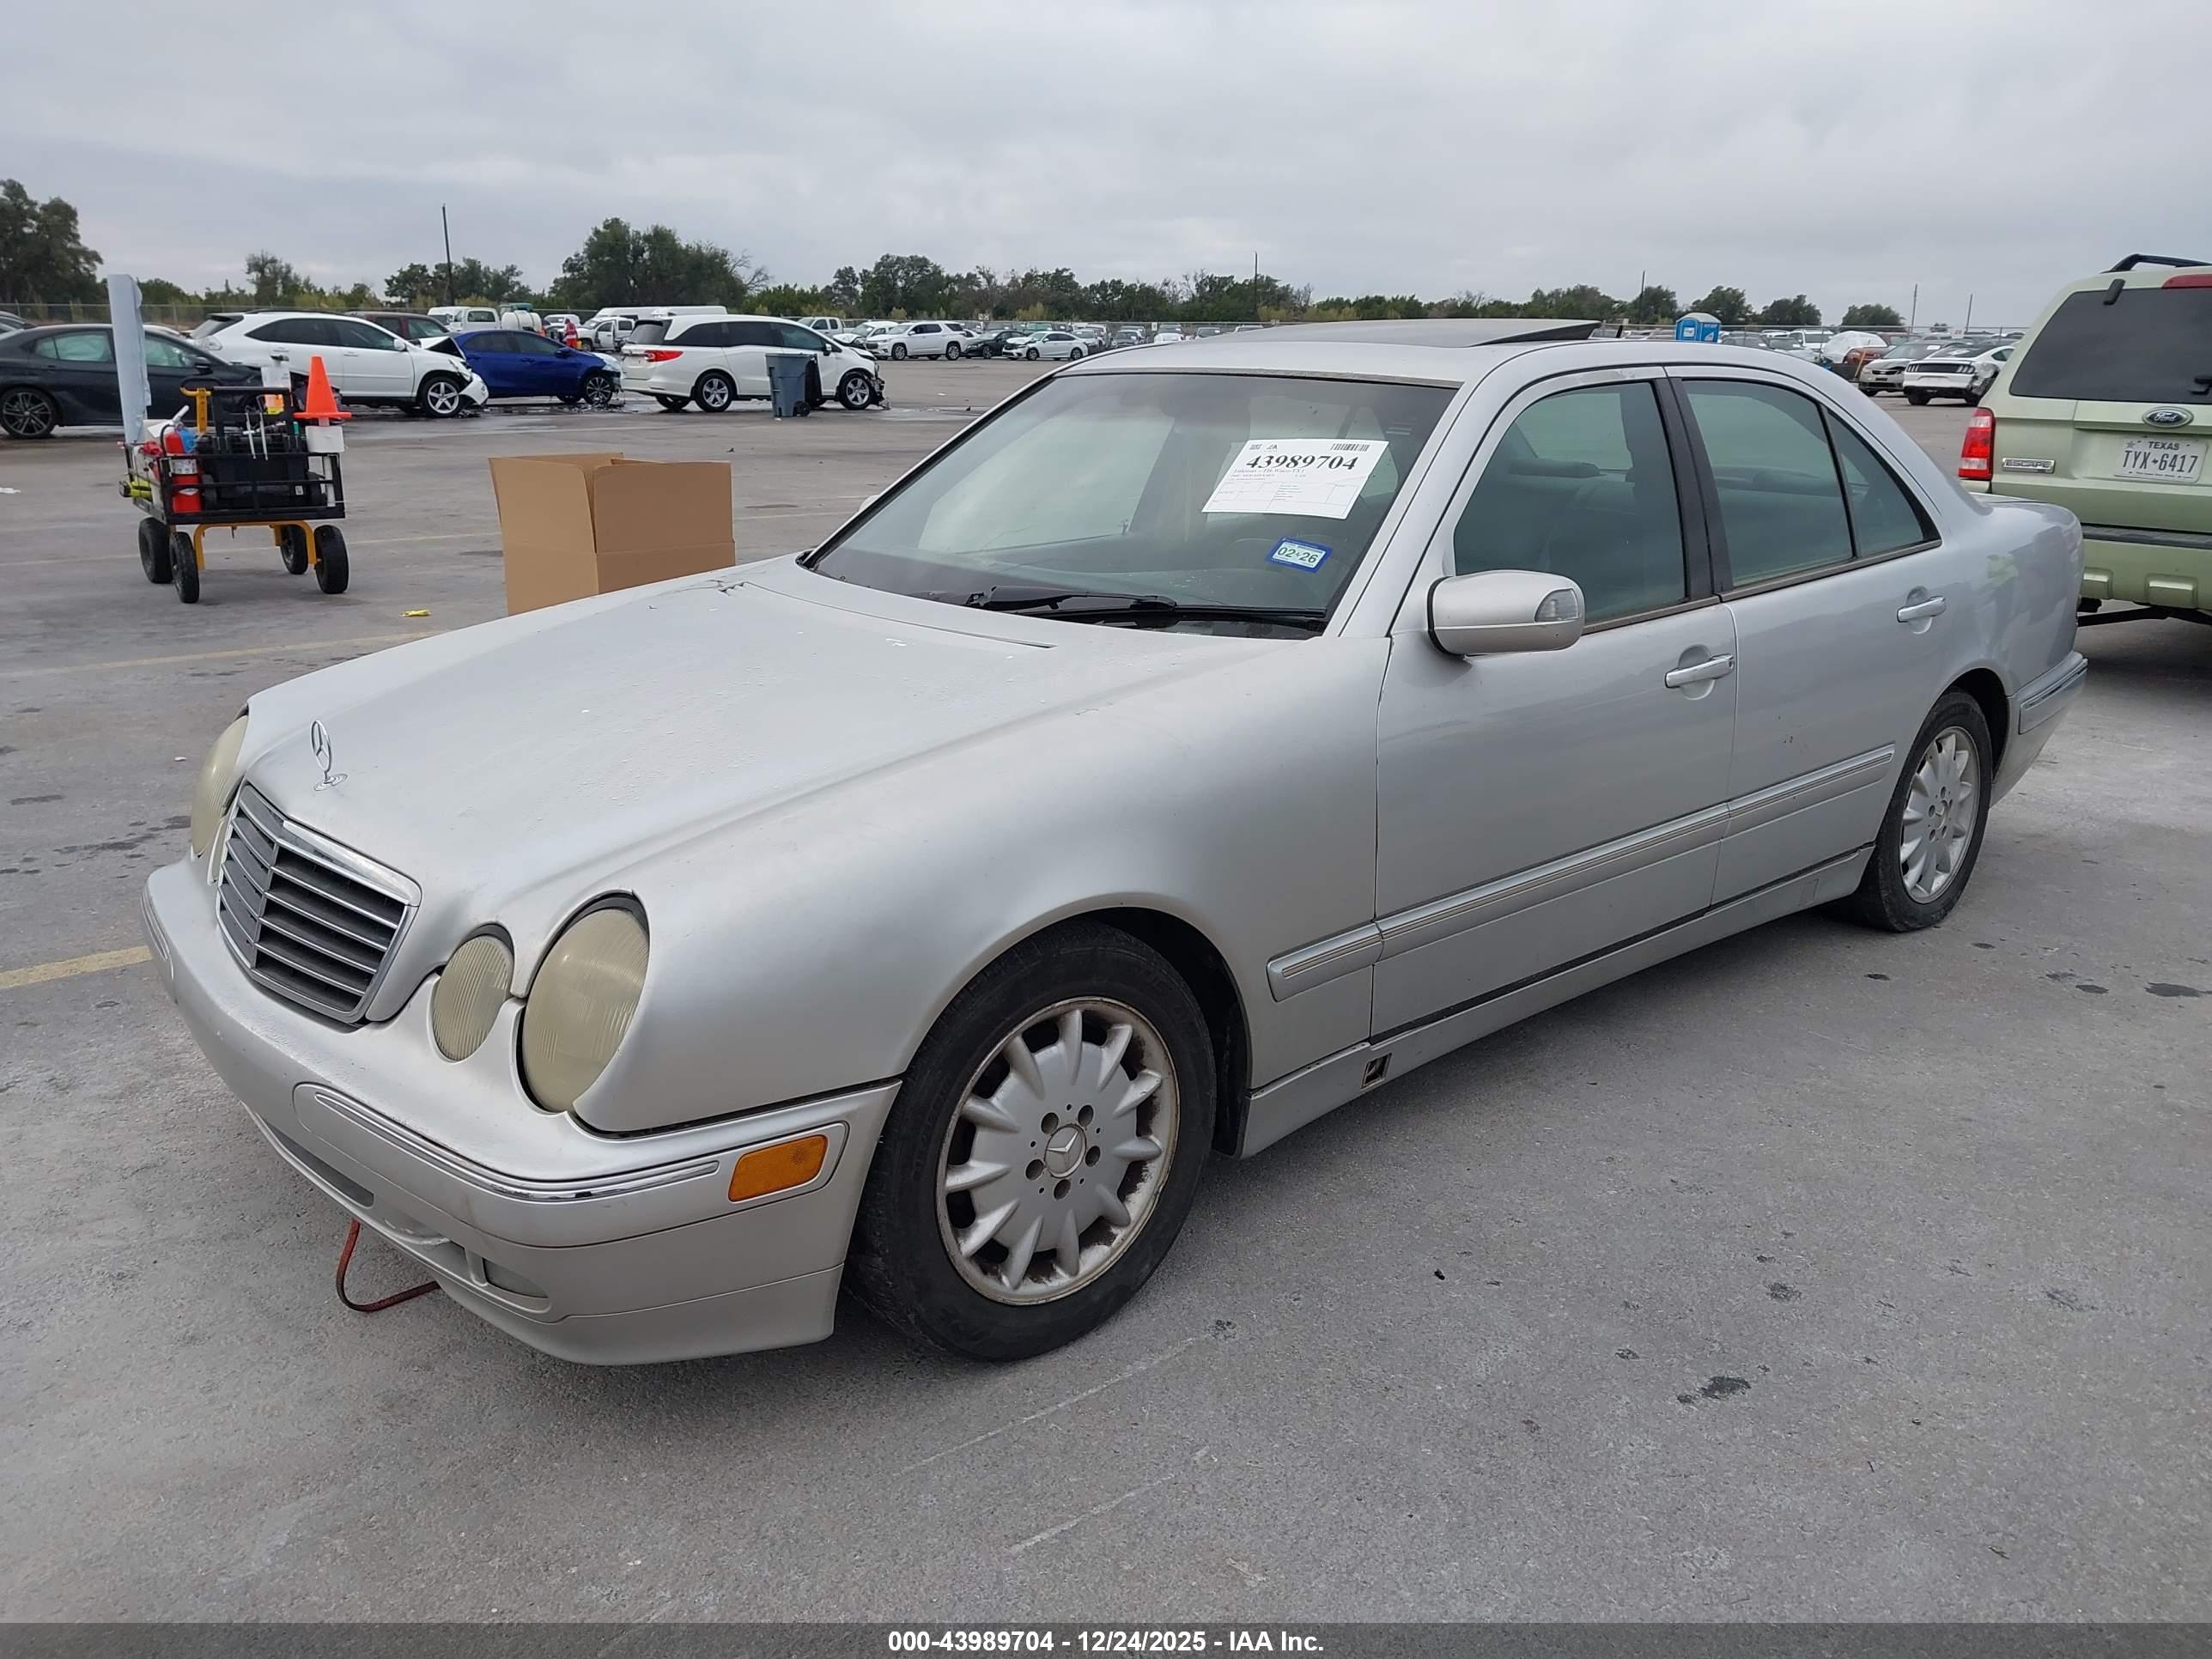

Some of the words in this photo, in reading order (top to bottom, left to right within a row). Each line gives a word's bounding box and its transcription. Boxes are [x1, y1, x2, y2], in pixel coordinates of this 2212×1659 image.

[2154, 411, 2179, 422] Ford
[2148, 441, 2180, 451] TEXAS
[1246, 454, 1359, 471] 43989704
[2005, 459, 2051, 469] ESCAPE
[2123, 450, 2151, 470] TYX
[2158, 453, 2199, 473] 6417
[1277, 546, 1297, 558] 02
[1298, 551, 1319, 563] 26
